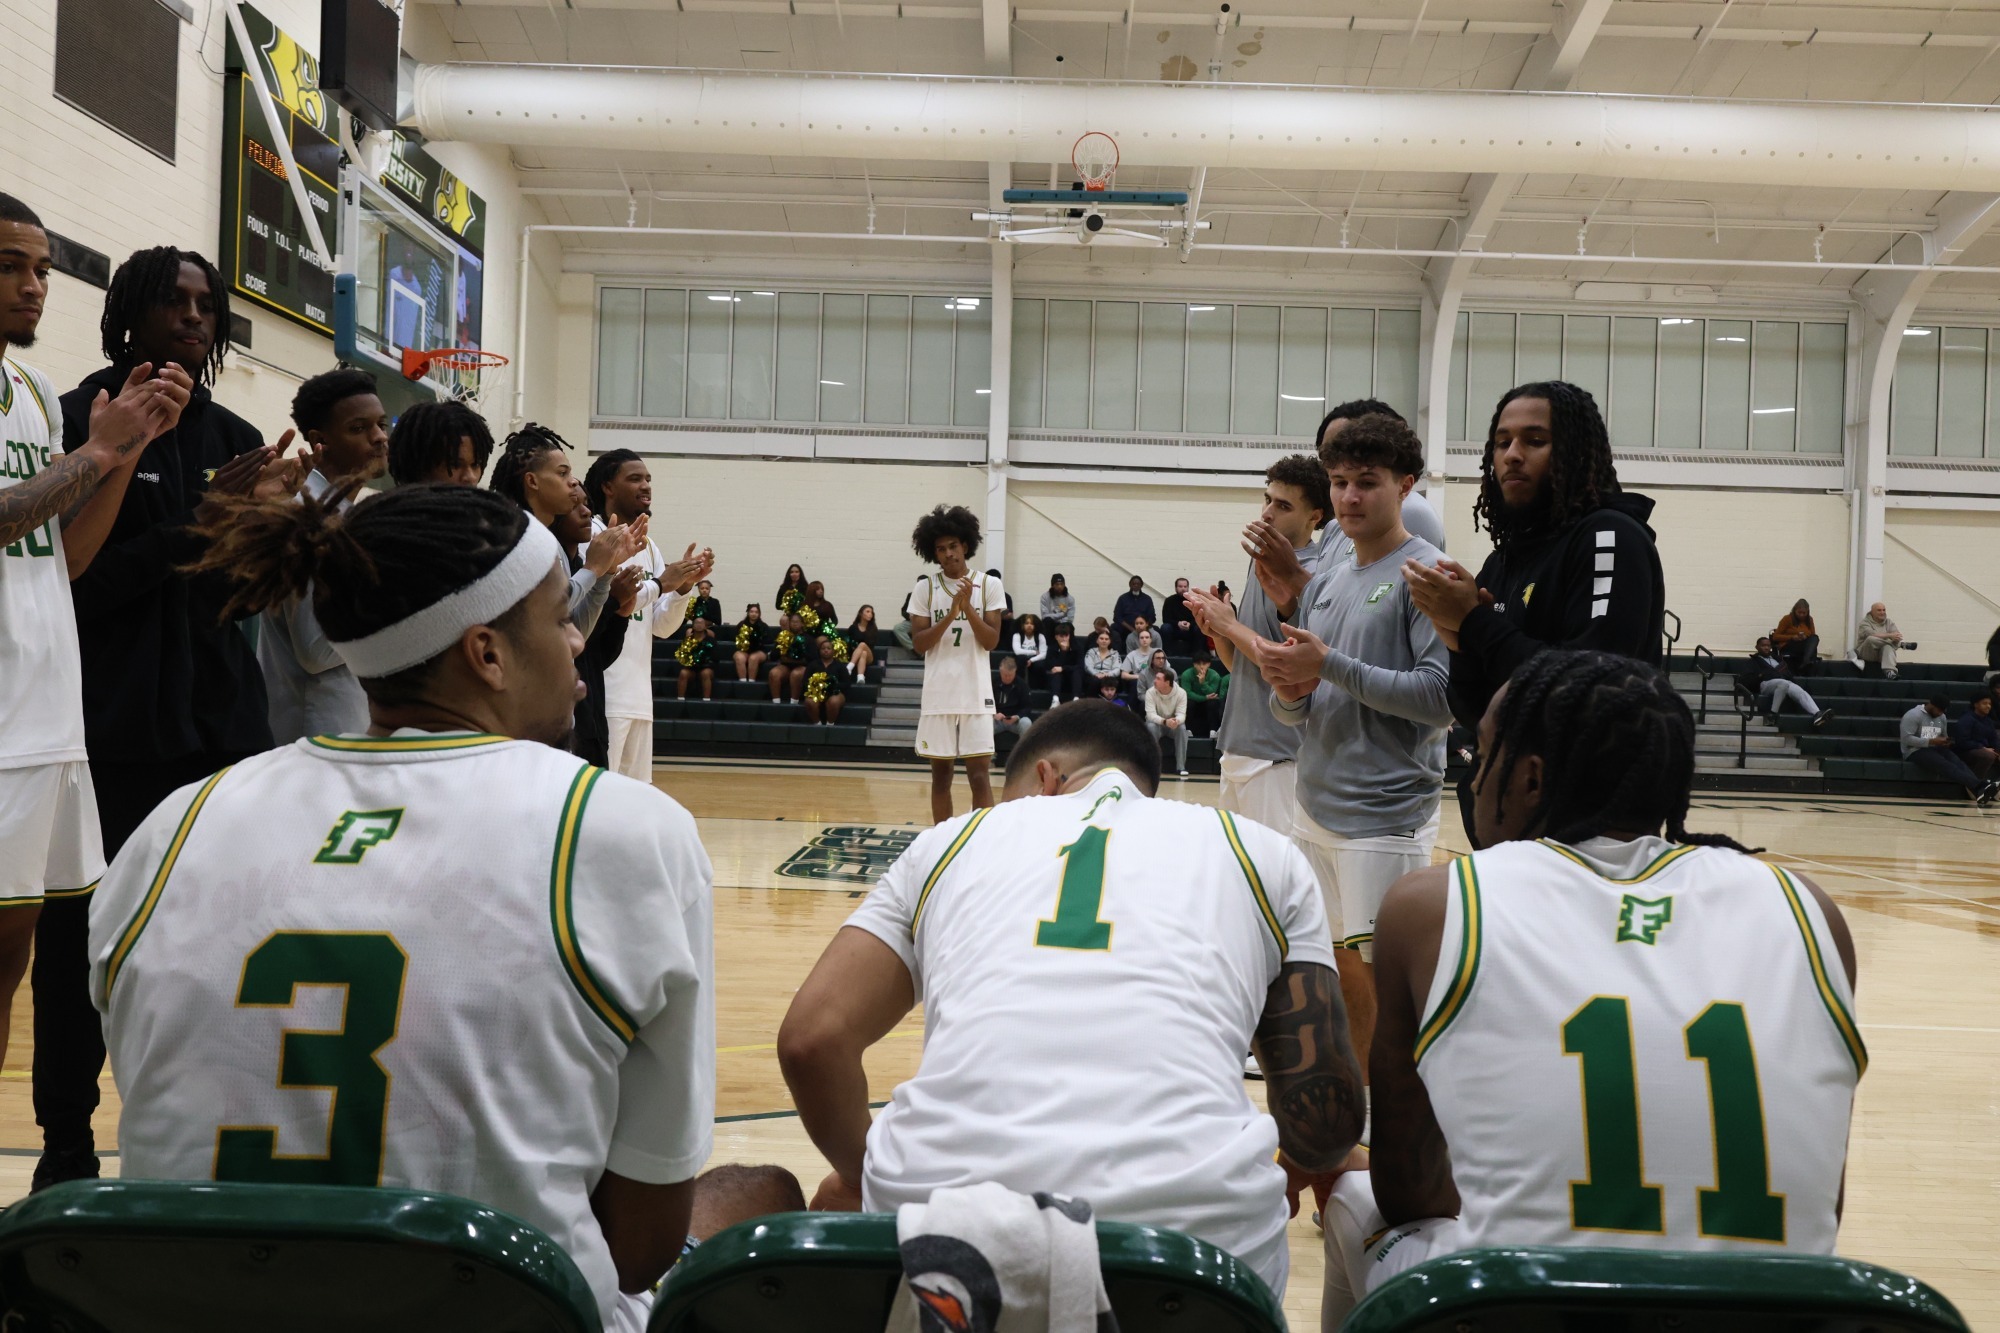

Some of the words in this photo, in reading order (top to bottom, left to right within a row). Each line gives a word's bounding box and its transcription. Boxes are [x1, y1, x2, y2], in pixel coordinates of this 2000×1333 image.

[308, 190, 329, 213] PERIOD
[247, 214, 269, 239] FOULS
[245, 273, 267, 295] SCORE
[305, 302, 326, 324] MATCH
[951, 627, 963, 647] 7
[313, 808, 405, 864] F
[1033, 823, 1114, 952] 1
[1616, 894, 1673, 945] F
[210, 929, 410, 1187] 3
[1560, 993, 1787, 1246] 11
